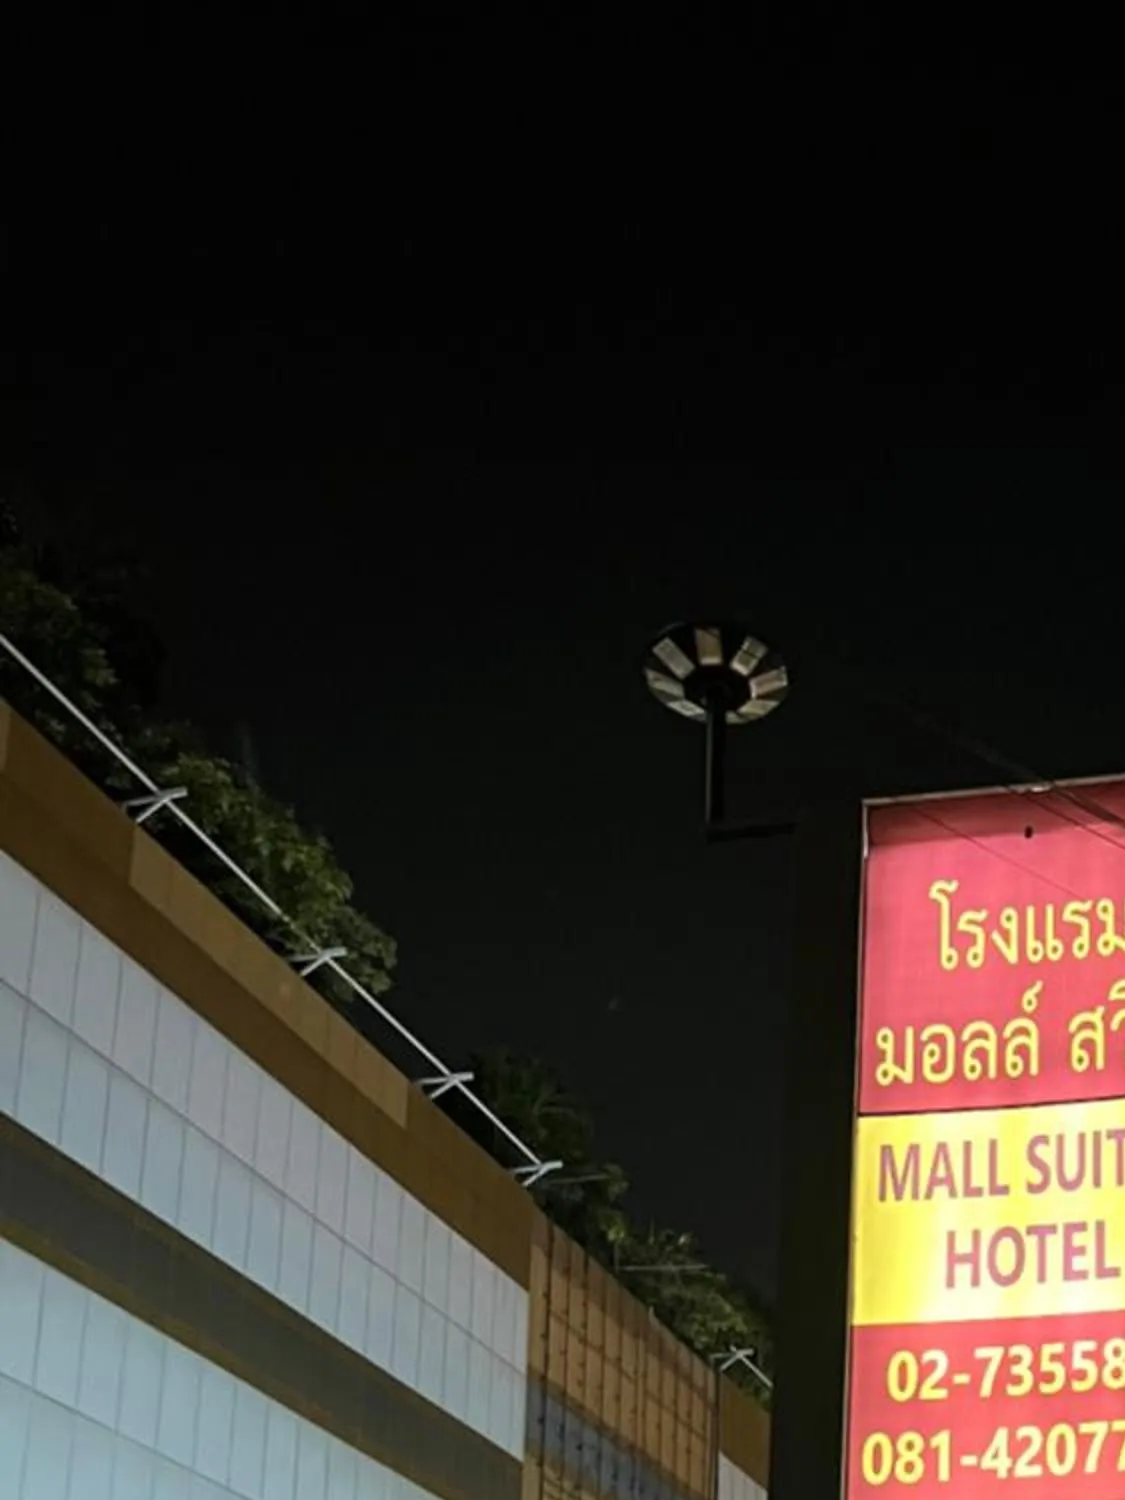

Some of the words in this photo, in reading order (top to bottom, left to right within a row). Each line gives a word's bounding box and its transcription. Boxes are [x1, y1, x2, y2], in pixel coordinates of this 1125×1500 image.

[875, 981, 1044, 1087] มอลล์
[878, 1138, 1011, 1203] MALL
[945, 1220, 1122, 1289] HOTEL
